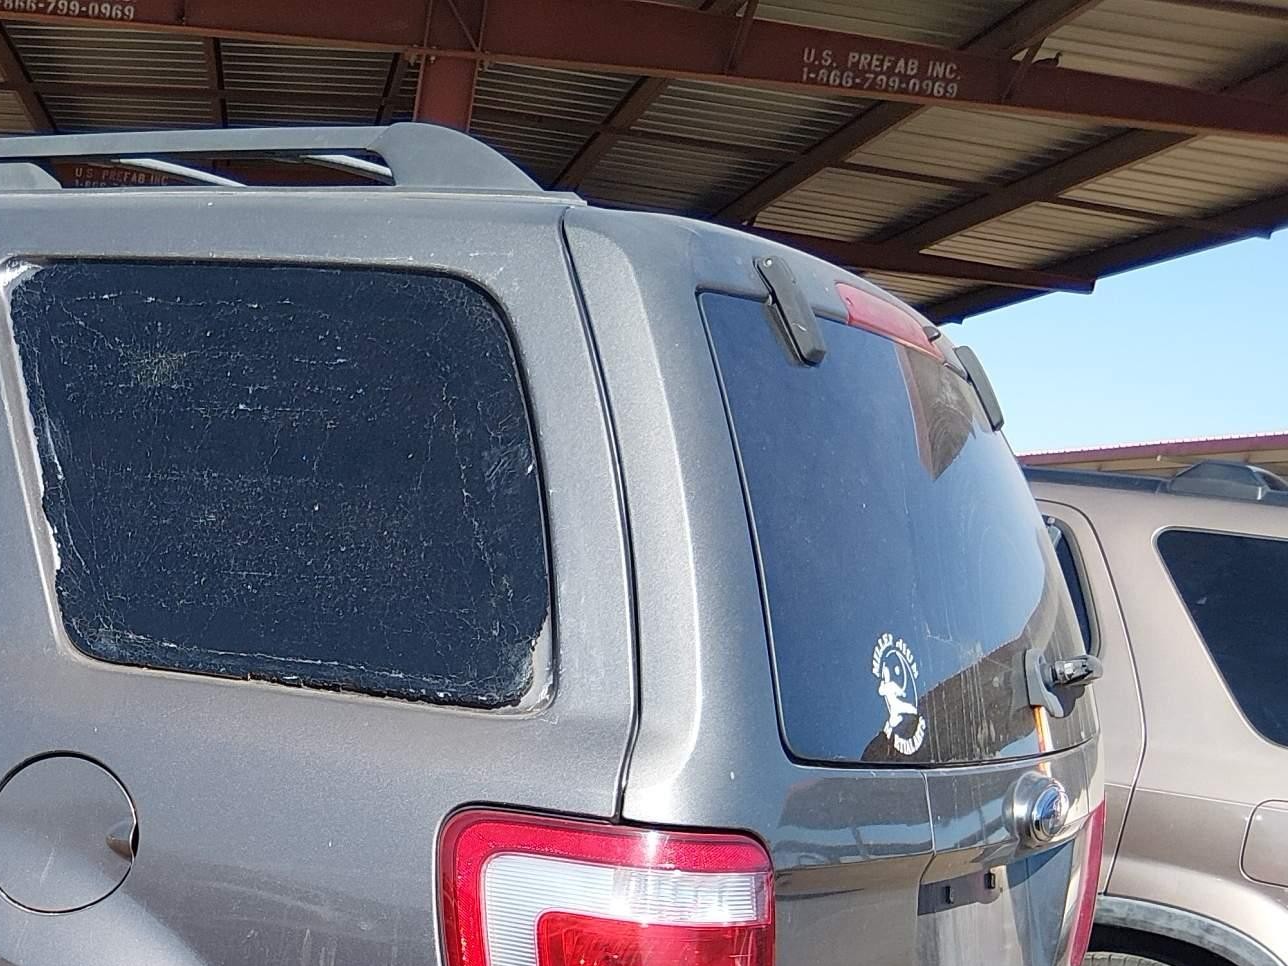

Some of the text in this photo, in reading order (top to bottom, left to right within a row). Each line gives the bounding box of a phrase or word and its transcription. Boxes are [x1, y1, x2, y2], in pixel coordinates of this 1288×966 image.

[802, 47, 962, 81] U.S. PREFAB INC.
